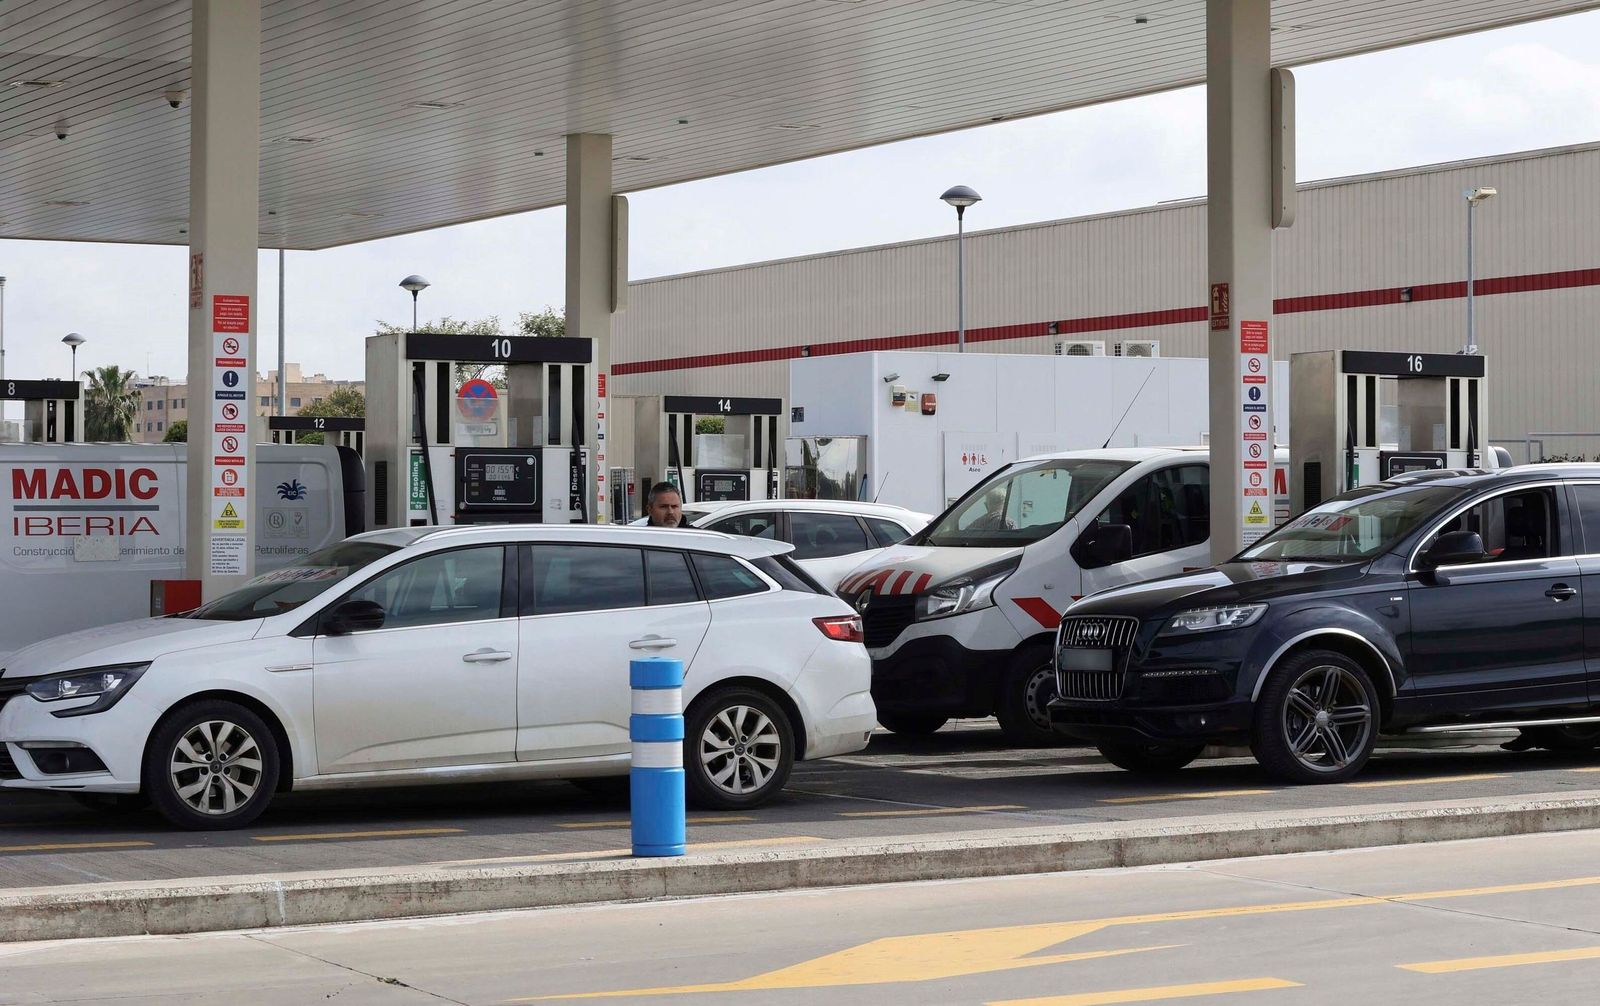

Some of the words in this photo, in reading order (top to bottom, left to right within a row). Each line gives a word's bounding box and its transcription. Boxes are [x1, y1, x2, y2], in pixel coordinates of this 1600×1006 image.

[492, 339, 512, 358] 10
[1407, 355, 1422, 372] 16
[8, 382, 15, 396] 8
[718, 399, 731, 412] 14
[314, 418, 325, 428] 12
[12, 468, 158, 500] MADIC
[14, 516, 160, 536] IBERIA
[13, 546, 73, 557] Construcció
[173, 546, 184, 555] de
